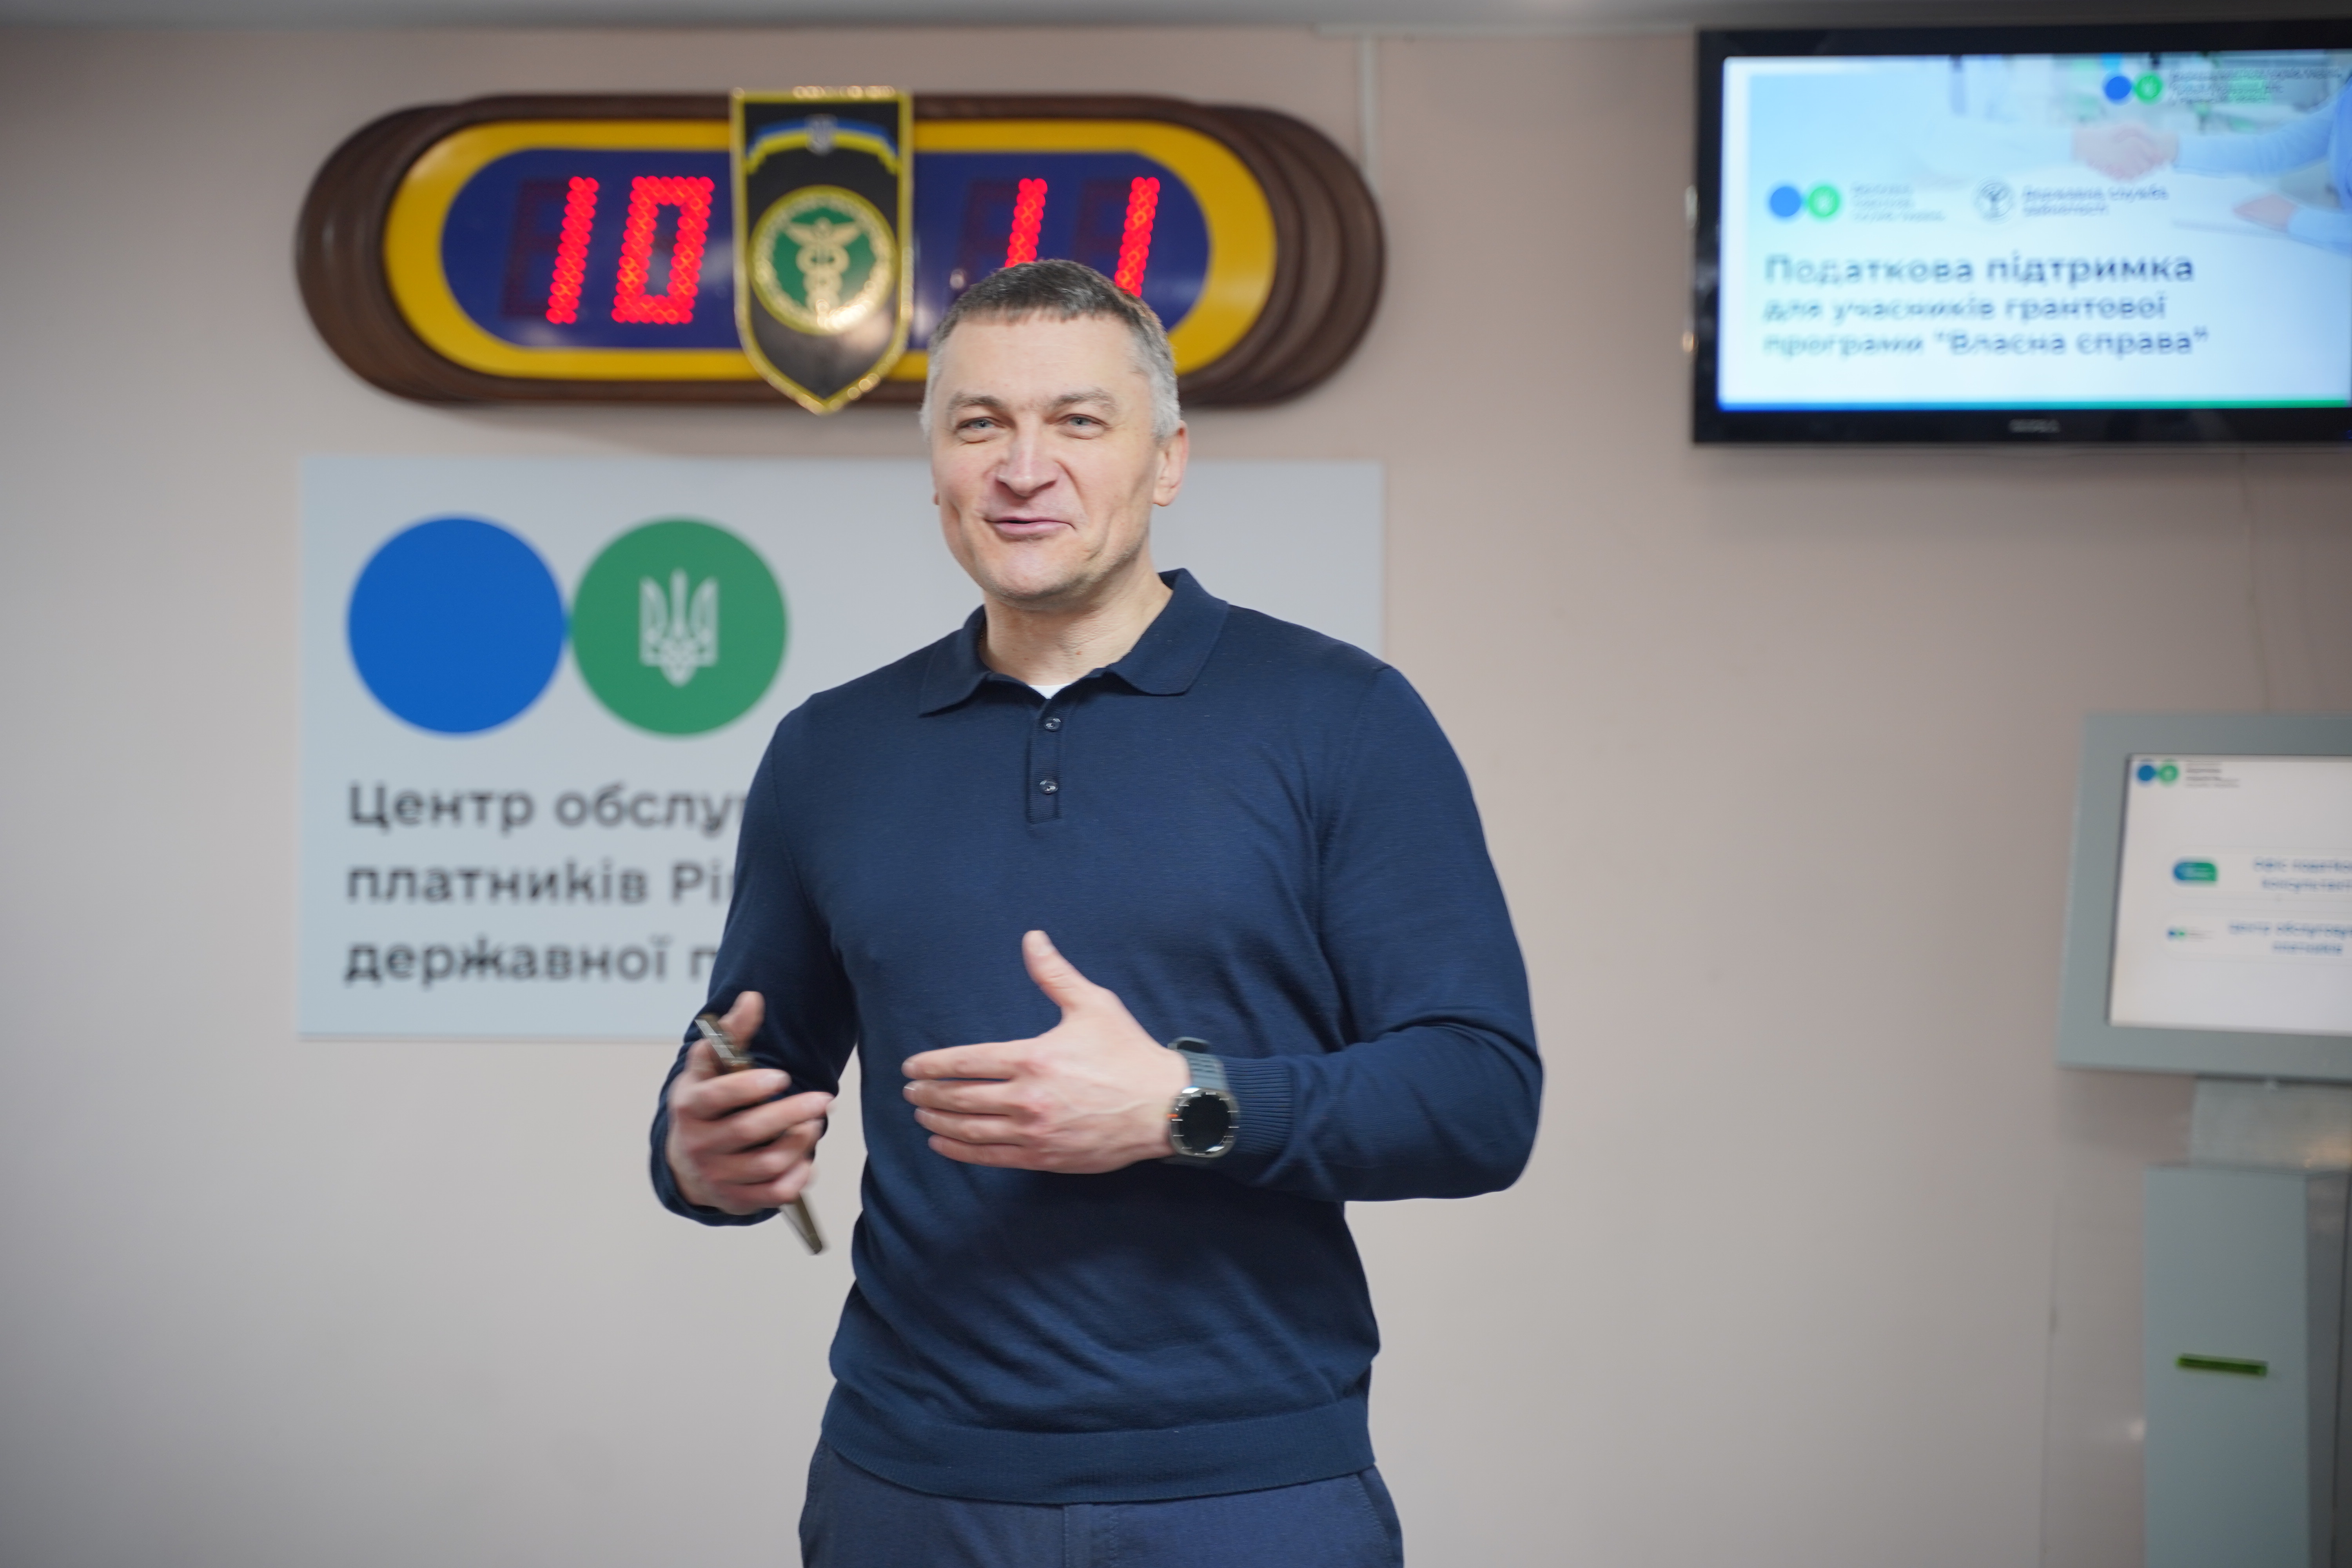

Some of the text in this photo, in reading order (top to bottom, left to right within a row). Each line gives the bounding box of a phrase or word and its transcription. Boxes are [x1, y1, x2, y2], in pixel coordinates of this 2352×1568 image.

[545, 175, 714, 324] 10
[1765, 251, 2194, 289] Податкова підтримка
[1831, 292, 1995, 326] учасників
[2004, 291, 2167, 325] грантової
[1765, 334, 1923, 359] програми
[347, 784, 534, 836] Центр
[347, 861, 648, 903] платників
[344, 935, 669, 988] державної
